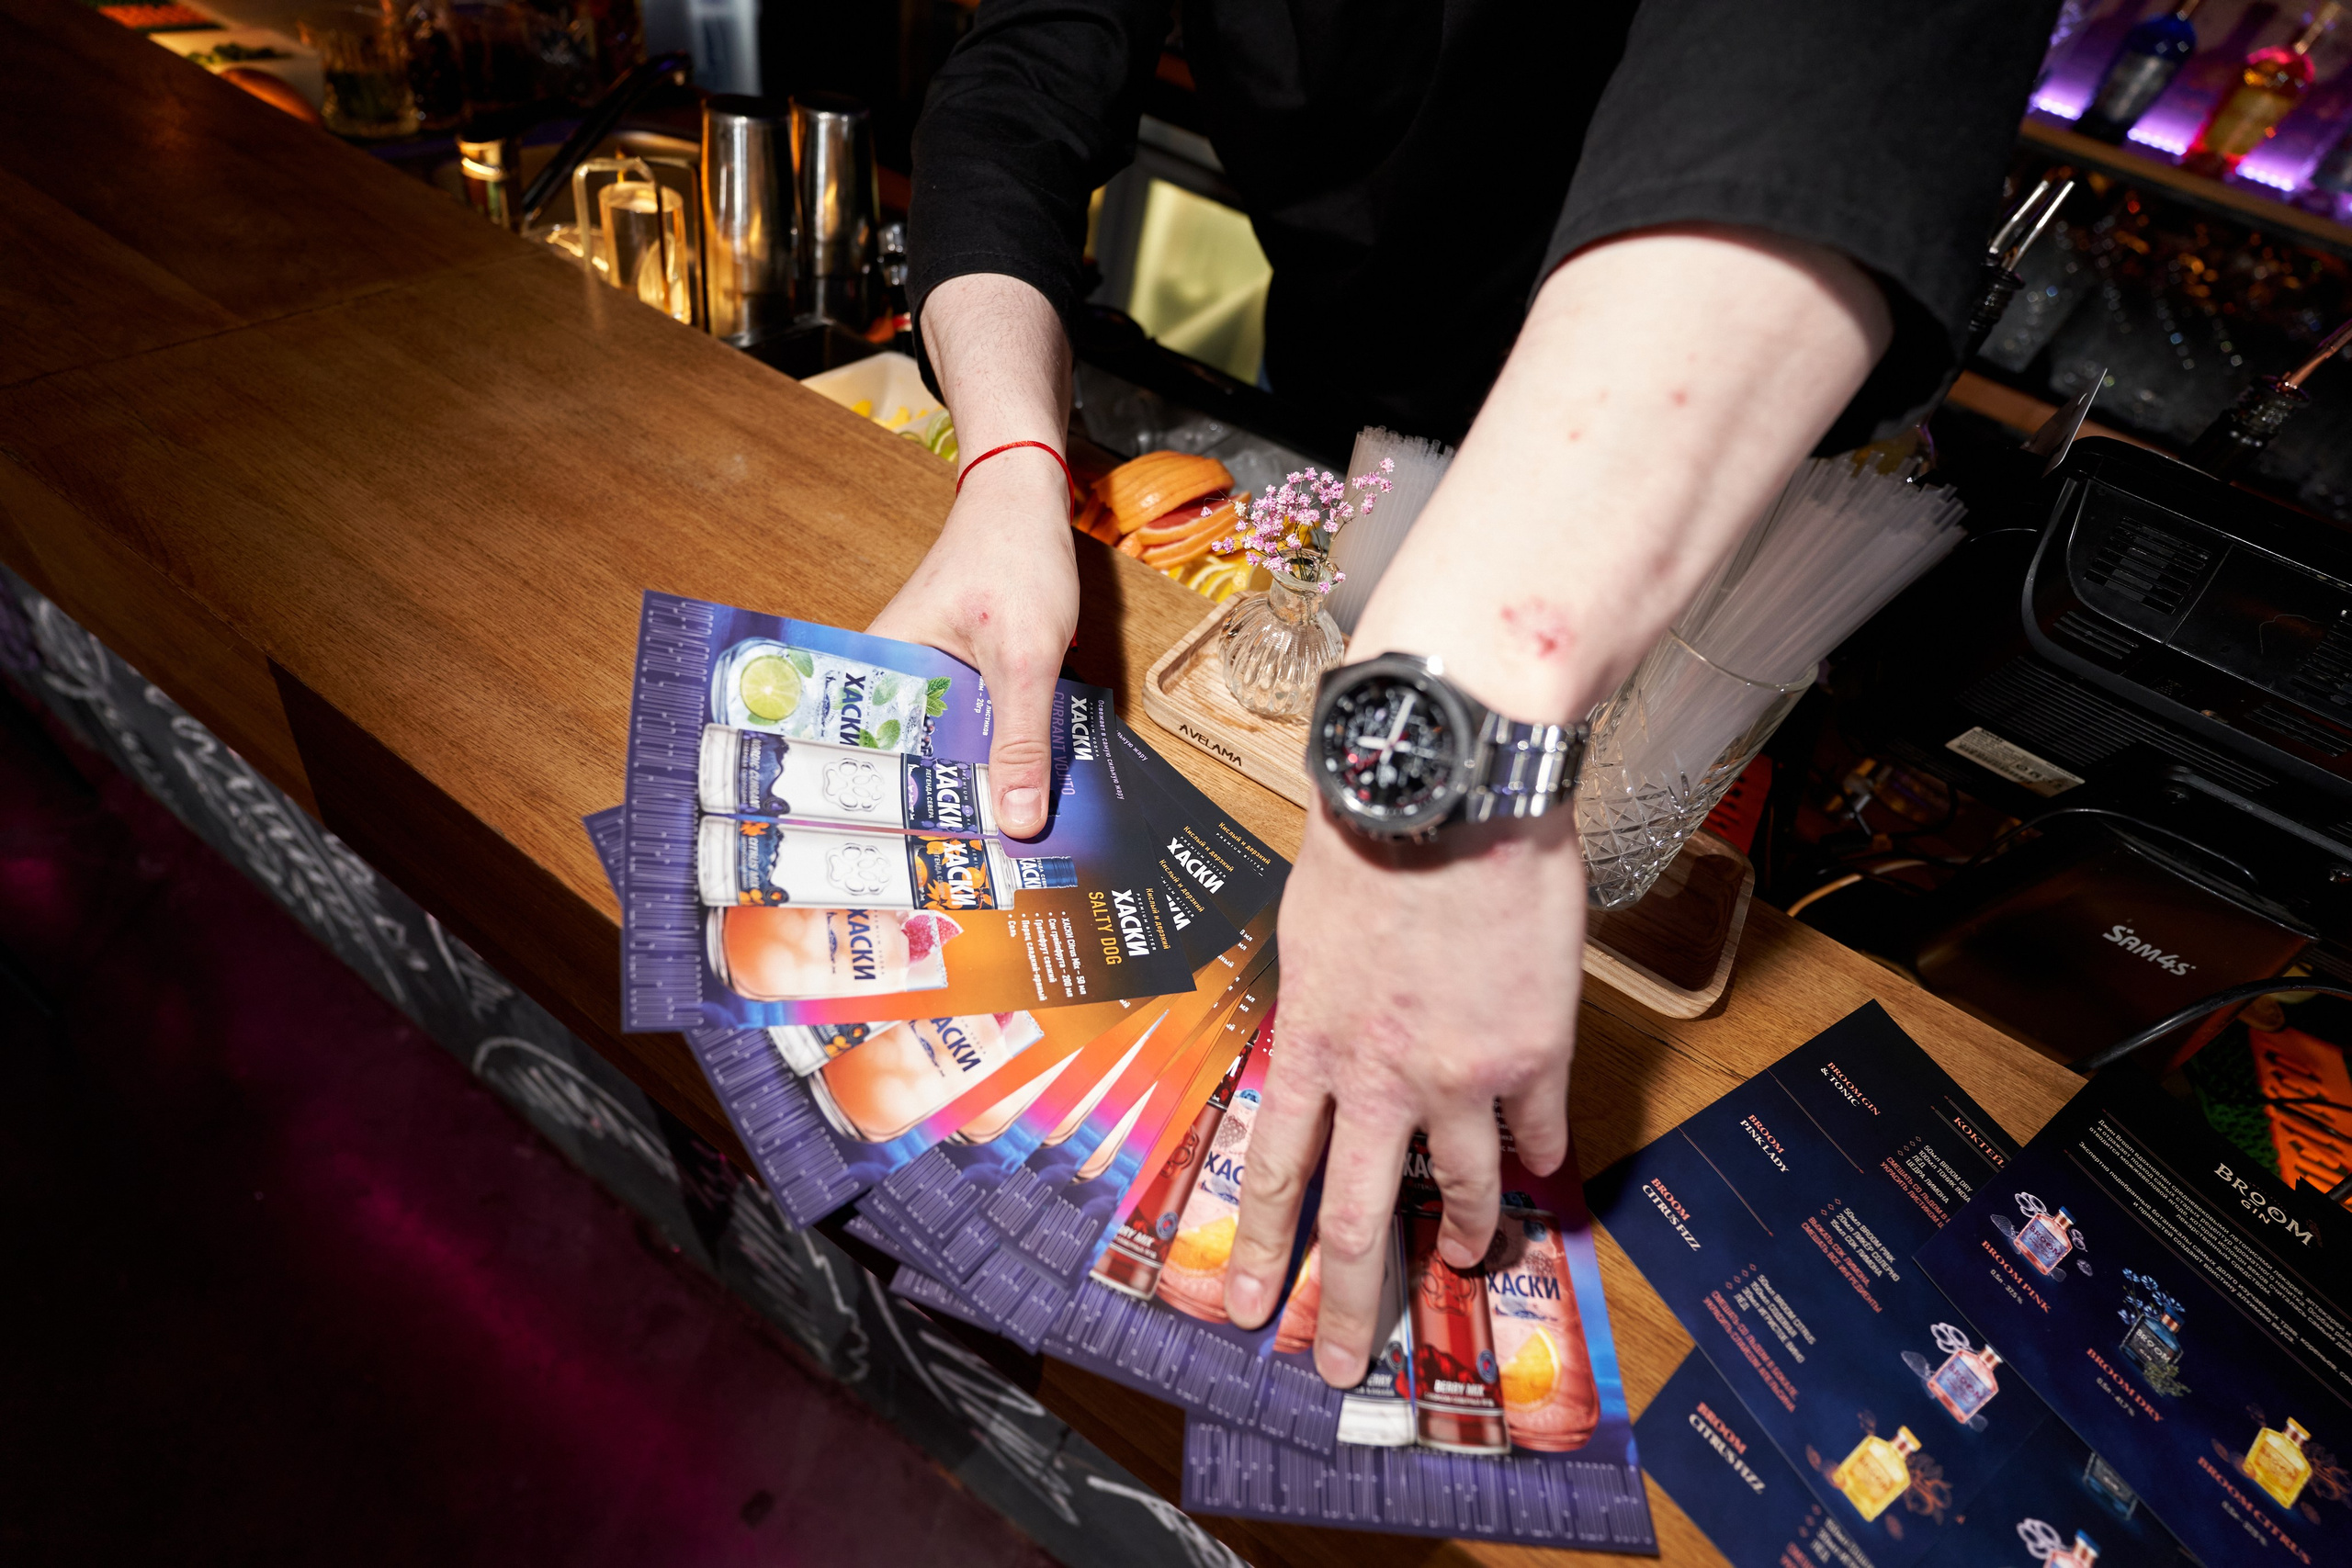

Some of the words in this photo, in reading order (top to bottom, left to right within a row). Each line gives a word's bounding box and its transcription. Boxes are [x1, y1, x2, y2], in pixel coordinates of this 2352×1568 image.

[839, 672, 865, 746] ХАСКИ
[973, 697, 983, 713] 20гр
[1051, 692, 1065, 750] CURRANT
[1070, 694, 1093, 760] ХАСКИ
[1098, 699, 1106, 730] Освежает
[1102, 738, 1111, 757] самую
[1107, 759, 1118, 782] сильную
[1114, 784, 1125, 798] жару
[1177, 722, 1245, 766] AVELAMA
[748, 737, 762, 770] NORDIC
[1054, 755, 1075, 795] VOJITO
[1131, 745, 1148, 762] жару
[749, 768, 760, 808] CURRANT
[935, 763, 962, 827] ХАСКИ
[748, 837, 757, 869] CITRUS
[1165, 836, 1224, 894] ХАСКИ
[1180, 836, 1204, 859] PREMIUM
[1205, 860, 1226, 878] BITTER
[1182, 825, 1206, 847] Кислый
[1208, 849, 1234, 873] дерзкий
[1215, 831, 1241, 853] PREMIUM
[1242, 853, 1264, 871] BITTER
[1217, 821, 1242, 842] Кислый
[1244, 842, 1271, 866] дерзкий
[750, 870, 759, 888] MIX
[943, 842, 976, 904] ХАСКИ
[1159, 858, 1180, 883] Кислый
[1180, 886, 1204, 913] дерзкий
[1007, 919, 1018, 937] Соль
[1021, 919, 1033, 940] Перец
[1047, 918, 1057, 929] Сок
[1061, 917, 1073, 937] ХАСКИ
[1088, 891, 1114, 931] SALTY
[1111, 887, 1149, 957] ХАСКИ
[1136, 892, 1148, 922] PREMIUM
[1145, 926, 1156, 950] BITTER
[1145, 886, 1160, 913] Кислый
[1154, 920, 1170, 949] дерзкий
[845, 908, 876, 980] ХАСКИ
[1033, 919, 1050, 954] Грейпфрут
[1043, 955, 1057, 982] свежий
[1049, 931, 1067, 967] грейпфрута
[1067, 938, 1078, 957] Citrus
[1071, 957, 1081, 969] Mix
[1100, 936, 1123, 964] DOG
[1061, 974, 1072, 986] 200
[1064, 987, 1073, 997] мл
[1075, 975, 1085, 983] 50
[1078, 985, 1086, 994] мл
[930, 1009, 981, 1073] АСКИ
[1819, 1066, 1830, 1077] &
[1827, 1074, 1860, 1108] TONIC
[1826, 1061, 1862, 1098] BROOM
[1860, 1096, 1881, 1116] GIN
[1739, 1118, 1765, 1146] PINK
[1761, 1143, 1789, 1173] LADY
[1747, 1113, 1785, 1154] BROOM
[1952, 1115, 2007, 1168] КОКТЕЙ
[1203, 1149, 1245, 1185] ХАС
[1885, 1156, 1915, 1185] СМЕШАТЬ
[1912, 1182, 1923, 1193] СО
[1919, 1191, 1942, 1214] ЛЬДОМ
[1905, 1158, 1926, 1179] ЦЕДРА
[1923, 1177, 1950, 1203] ЛИМОНА
[1917, 1149, 1938, 1169] 100мл
[1936, 1168, 1956, 1188] ТОНИК
[1923, 1144, 1941, 1162] 50мл
[1939, 1159, 1961, 1181] BROOM
[1958, 1179, 1973, 1193] DRY
[1650, 1177, 1690, 1221] BROOM
[1879, 1161, 1909, 1191] УКРАСИТЬ
[1905, 1189, 1939, 1223] ЛИСТИКОМ
[2213, 1160, 2314, 1246] BROOM
[2239, 1197, 2270, 1224] GIN
[1641, 1182, 1679, 1225] CITRUS
[1675, 1223, 1702, 1251] FIZZ
[1836, 1212, 1855, 1233] 20мл
[1842, 1206, 1862, 1227] 50мл
[1859, 1224, 1882, 1248] BROOM
[1879, 1246, 1895, 1263] PINK
[1800, 1221, 1829, 1254] СМЕШАТЬ
[1826, 1250, 1840, 1266] ВСЕ
[1830, 1242, 1847, 1258] СОК
[1844, 1235, 1859, 1250] СОК
[1855, 1247, 1883, 1277] ЛИМОНА
[2029, 1224, 2062, 1258] BROOM
[1485, 1269, 1561, 1299] ХАСКИ
[1981, 1239, 2022, 1284] BROOM
[2021, 1282, 2052, 1314] PINK
[2134, 1328, 2170, 1362] BROOM
[1434, 1379, 1464, 1394] BERRY
[1465, 1382, 1485, 1396] MIX
[2085, 1347, 2136, 1397] BROOM
[2133, 1393, 2164, 1422] DRY
[1687, 1412, 1738, 1465] CITRUS
[1695, 1400, 1748, 1455] BROOM
[2195, 1455, 2256, 1512] BROOM
[2251, 1507, 2313, 1566] CITRUS
